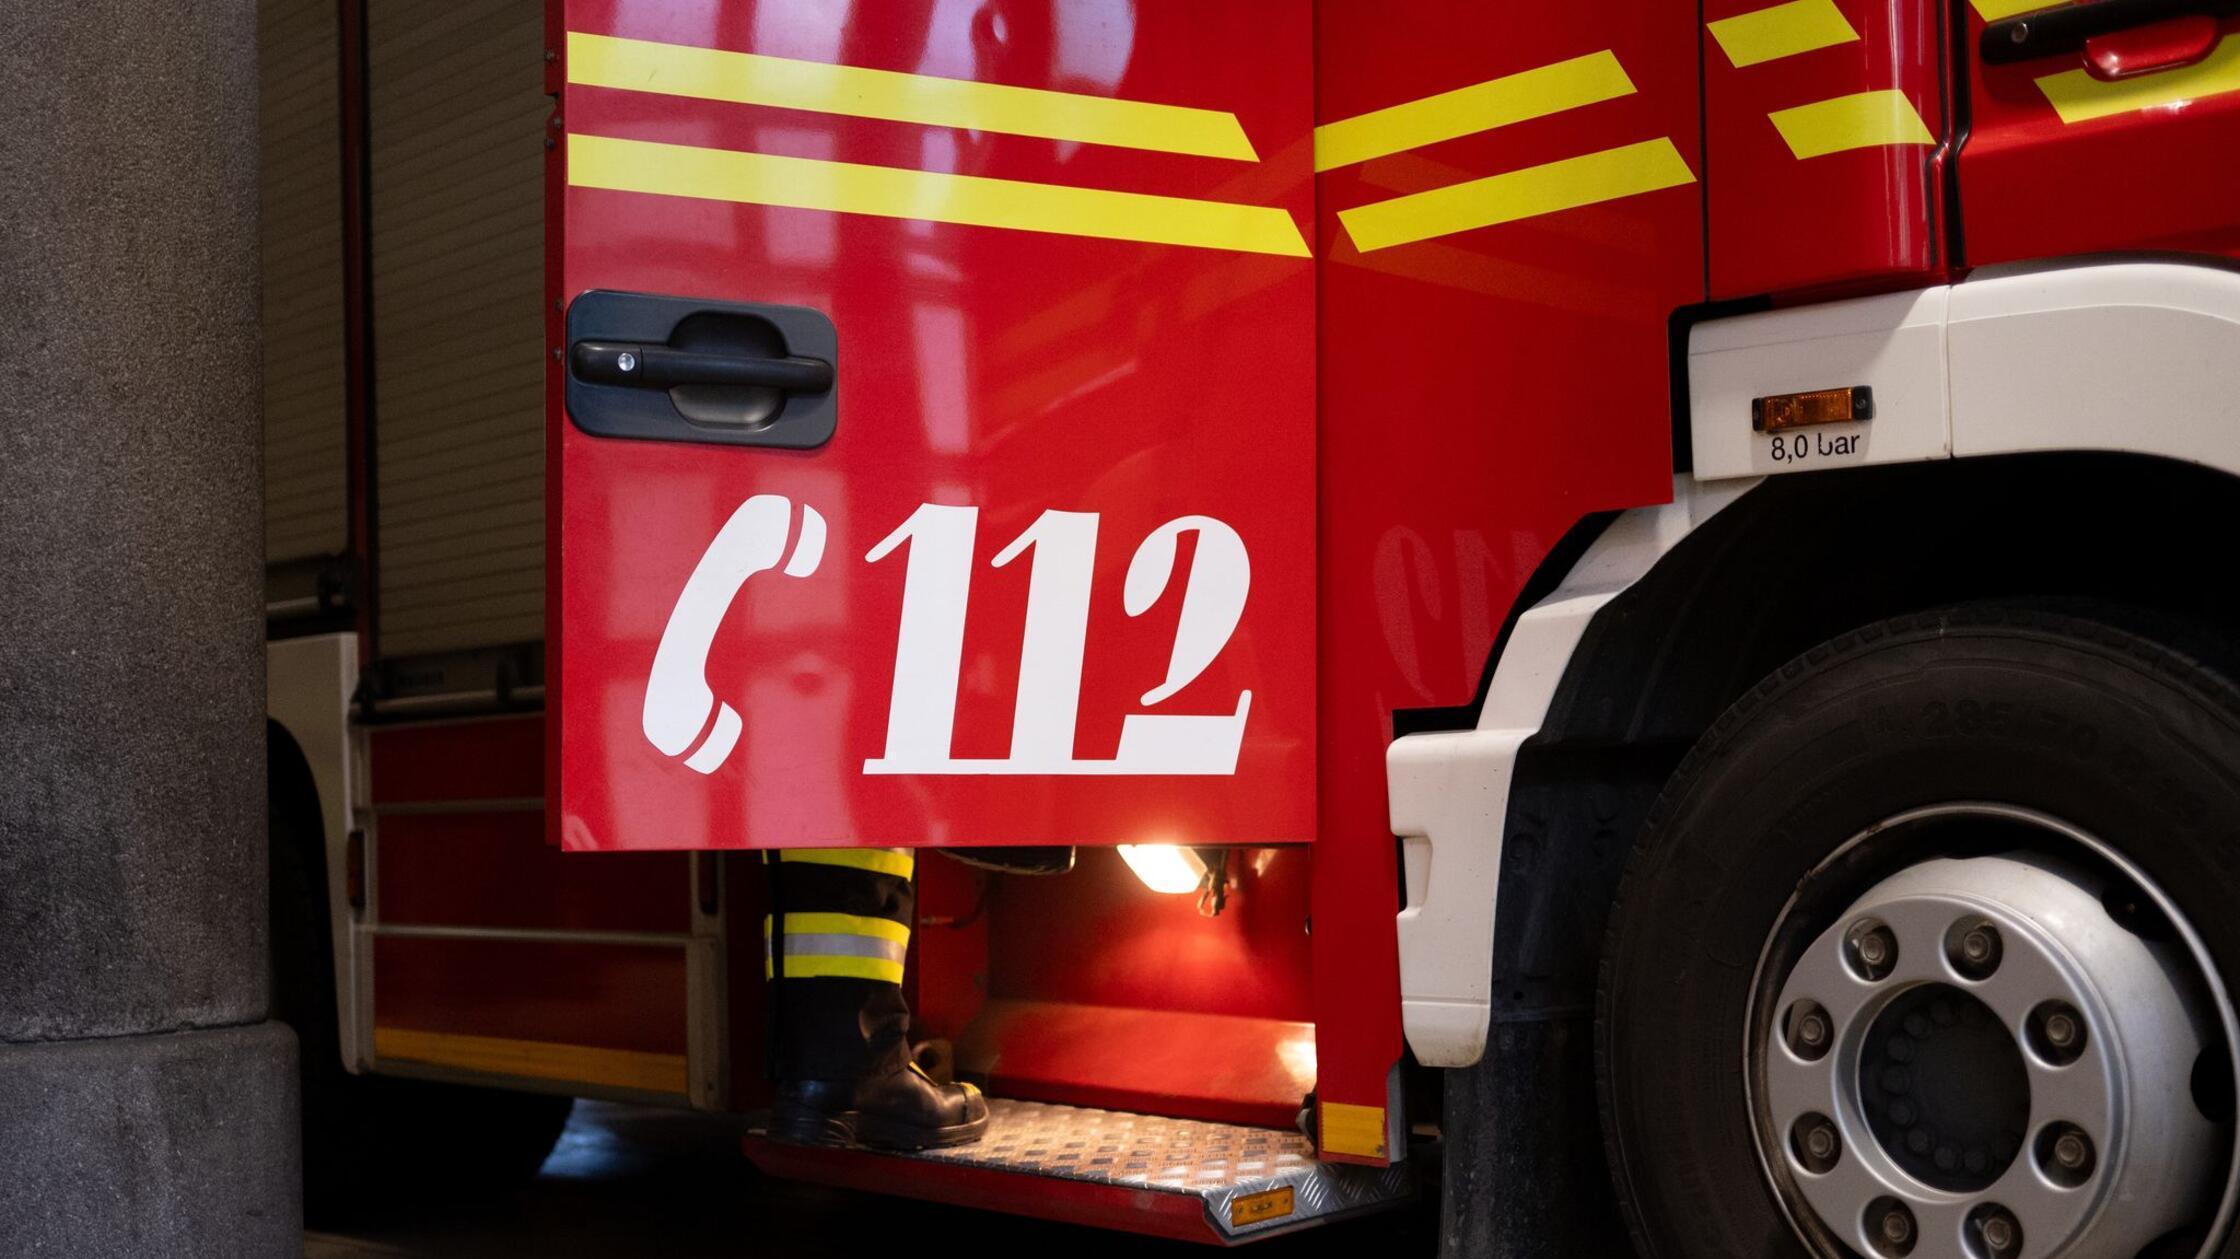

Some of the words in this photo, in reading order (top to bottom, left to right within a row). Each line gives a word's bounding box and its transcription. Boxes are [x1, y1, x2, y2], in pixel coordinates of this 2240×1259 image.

[1770, 434, 1809, 464] 8,0
[1817, 432, 1861, 456] bar
[862, 502, 1253, 776] 112
